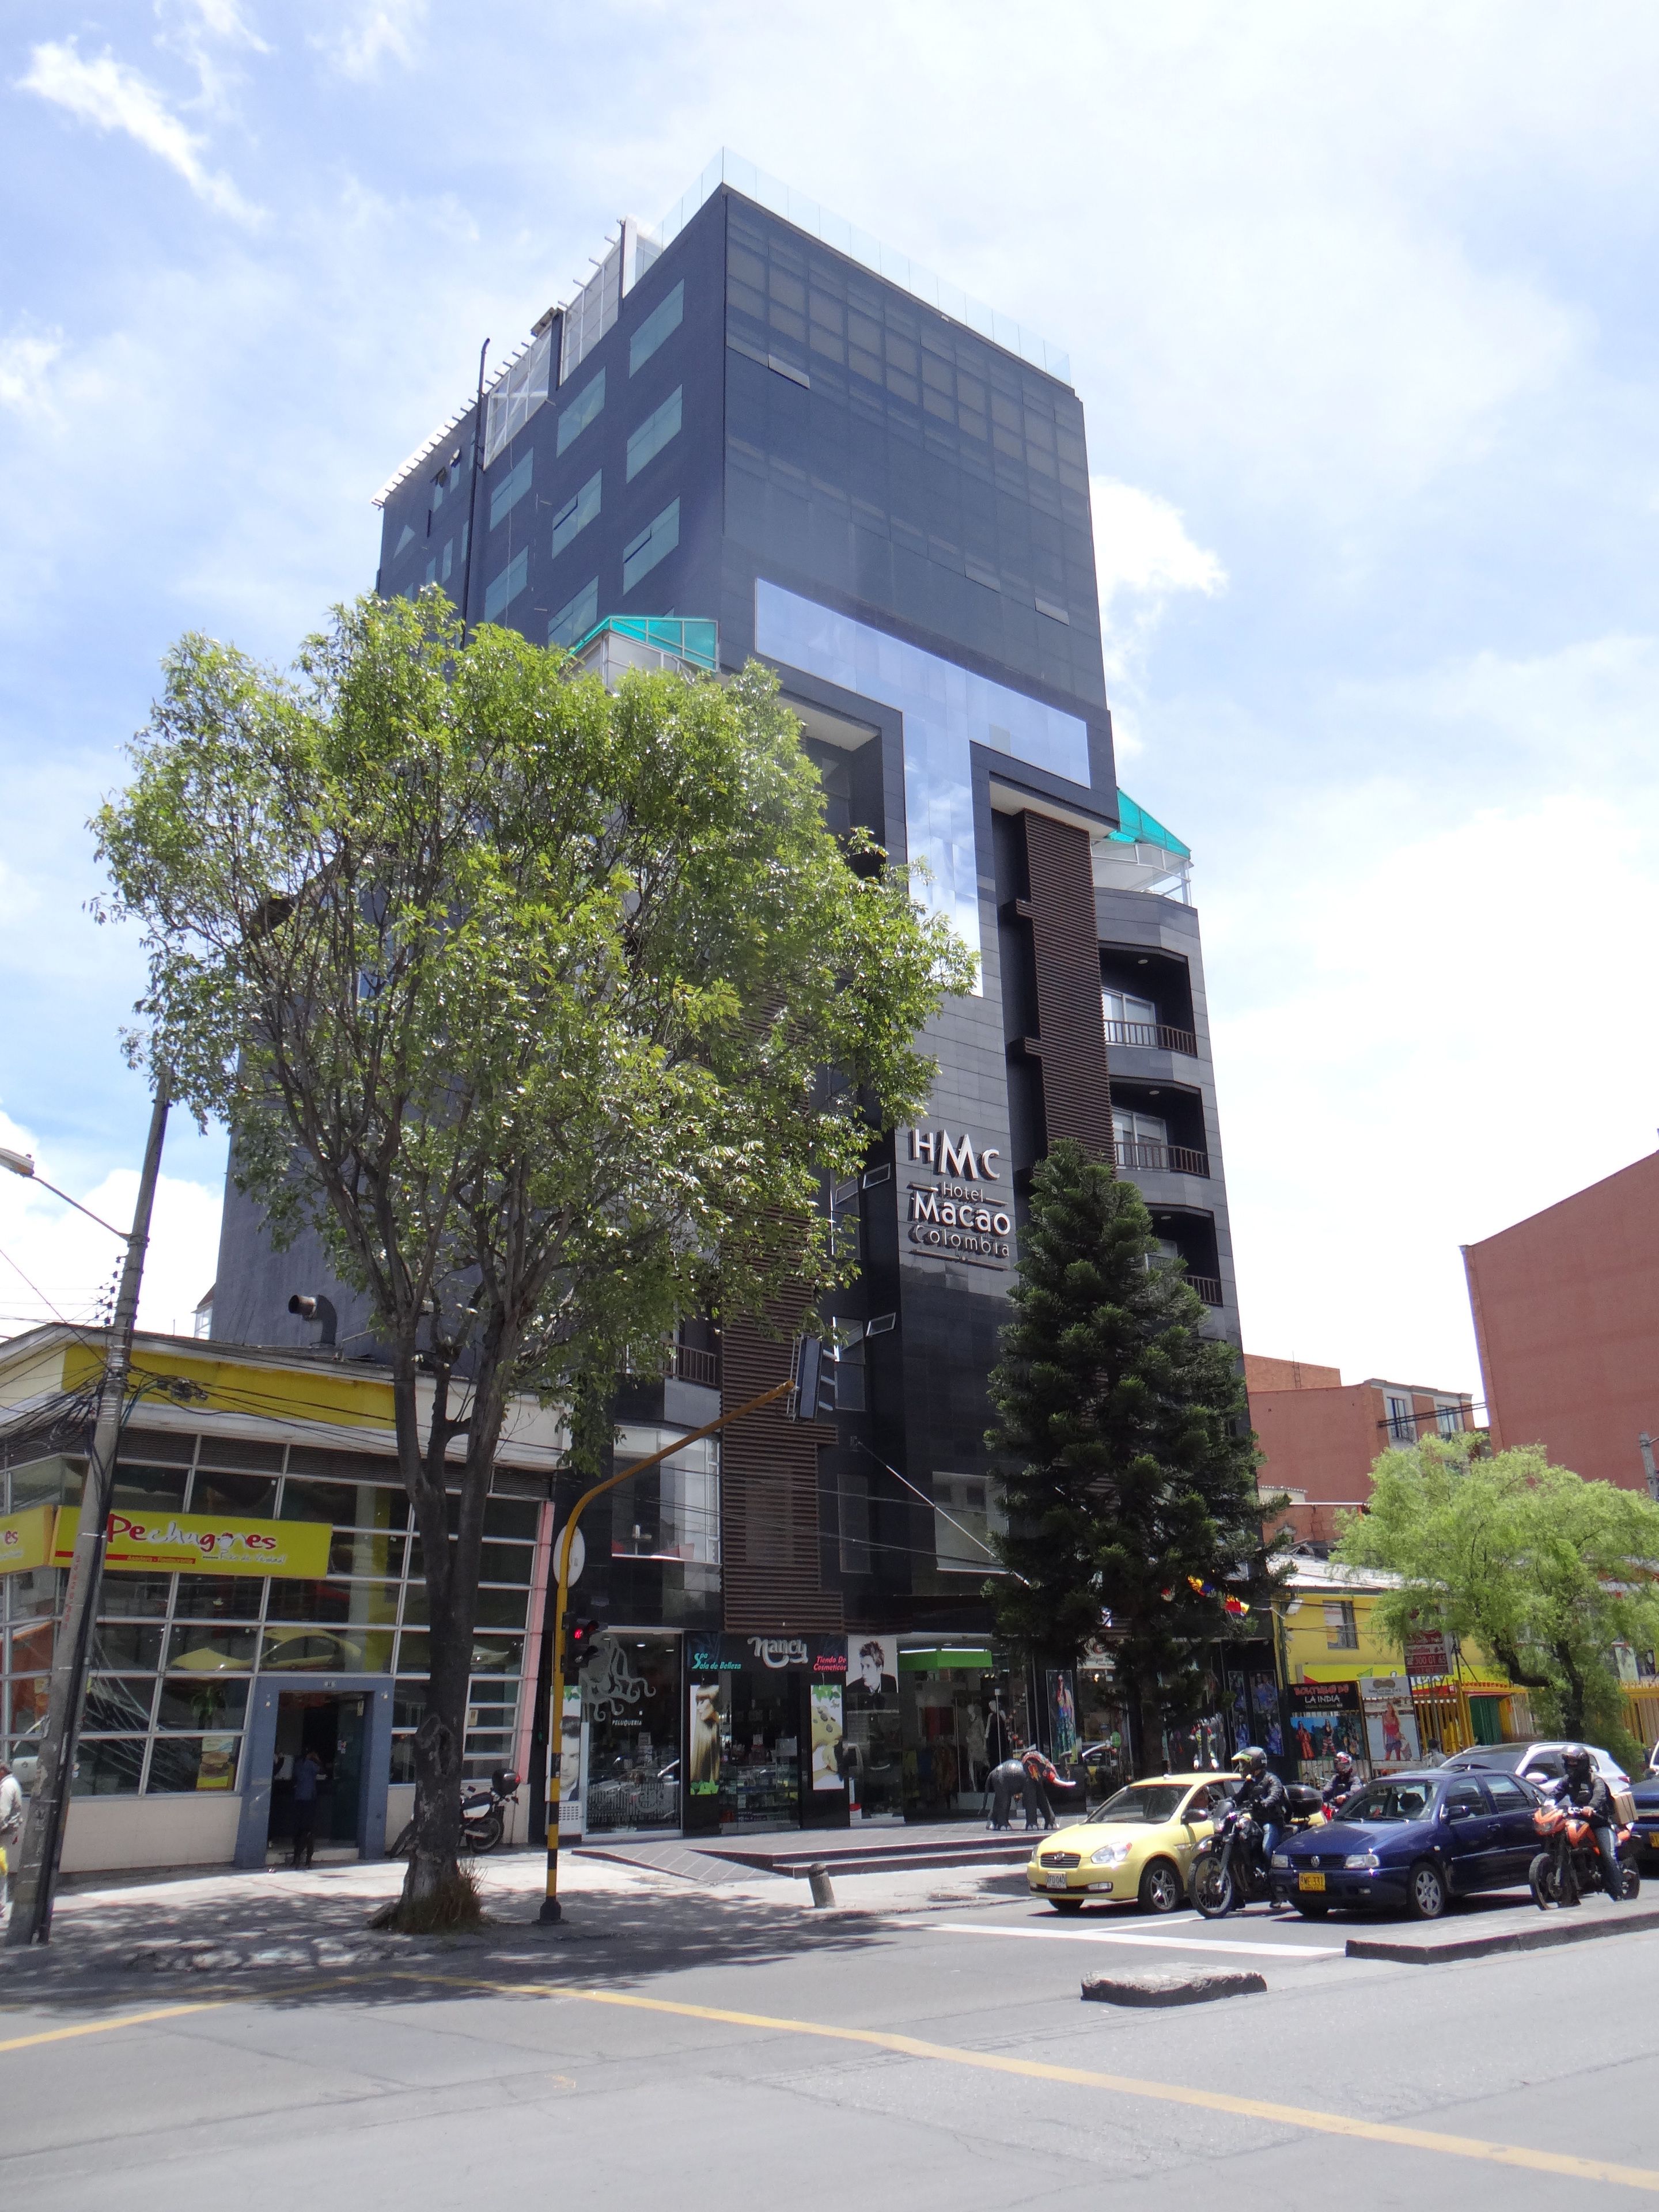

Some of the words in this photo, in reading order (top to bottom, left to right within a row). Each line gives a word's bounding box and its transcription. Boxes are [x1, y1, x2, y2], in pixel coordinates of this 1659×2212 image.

[911, 1129, 1001, 1180] HMC
[941, 1181, 984, 1203] Hotel
[913, 1191, 1011, 1235] Macao
[912, 1225, 1009, 1257] Colombia
[107, 1513, 277, 1552] Pechugones
[719, 1661, 741, 1669] Belleza
[813, 1663, 847, 1671] Cosmeticos
[816, 1655, 836, 1663] Tienda
[1317, 1695, 1340, 1703] INDIA
